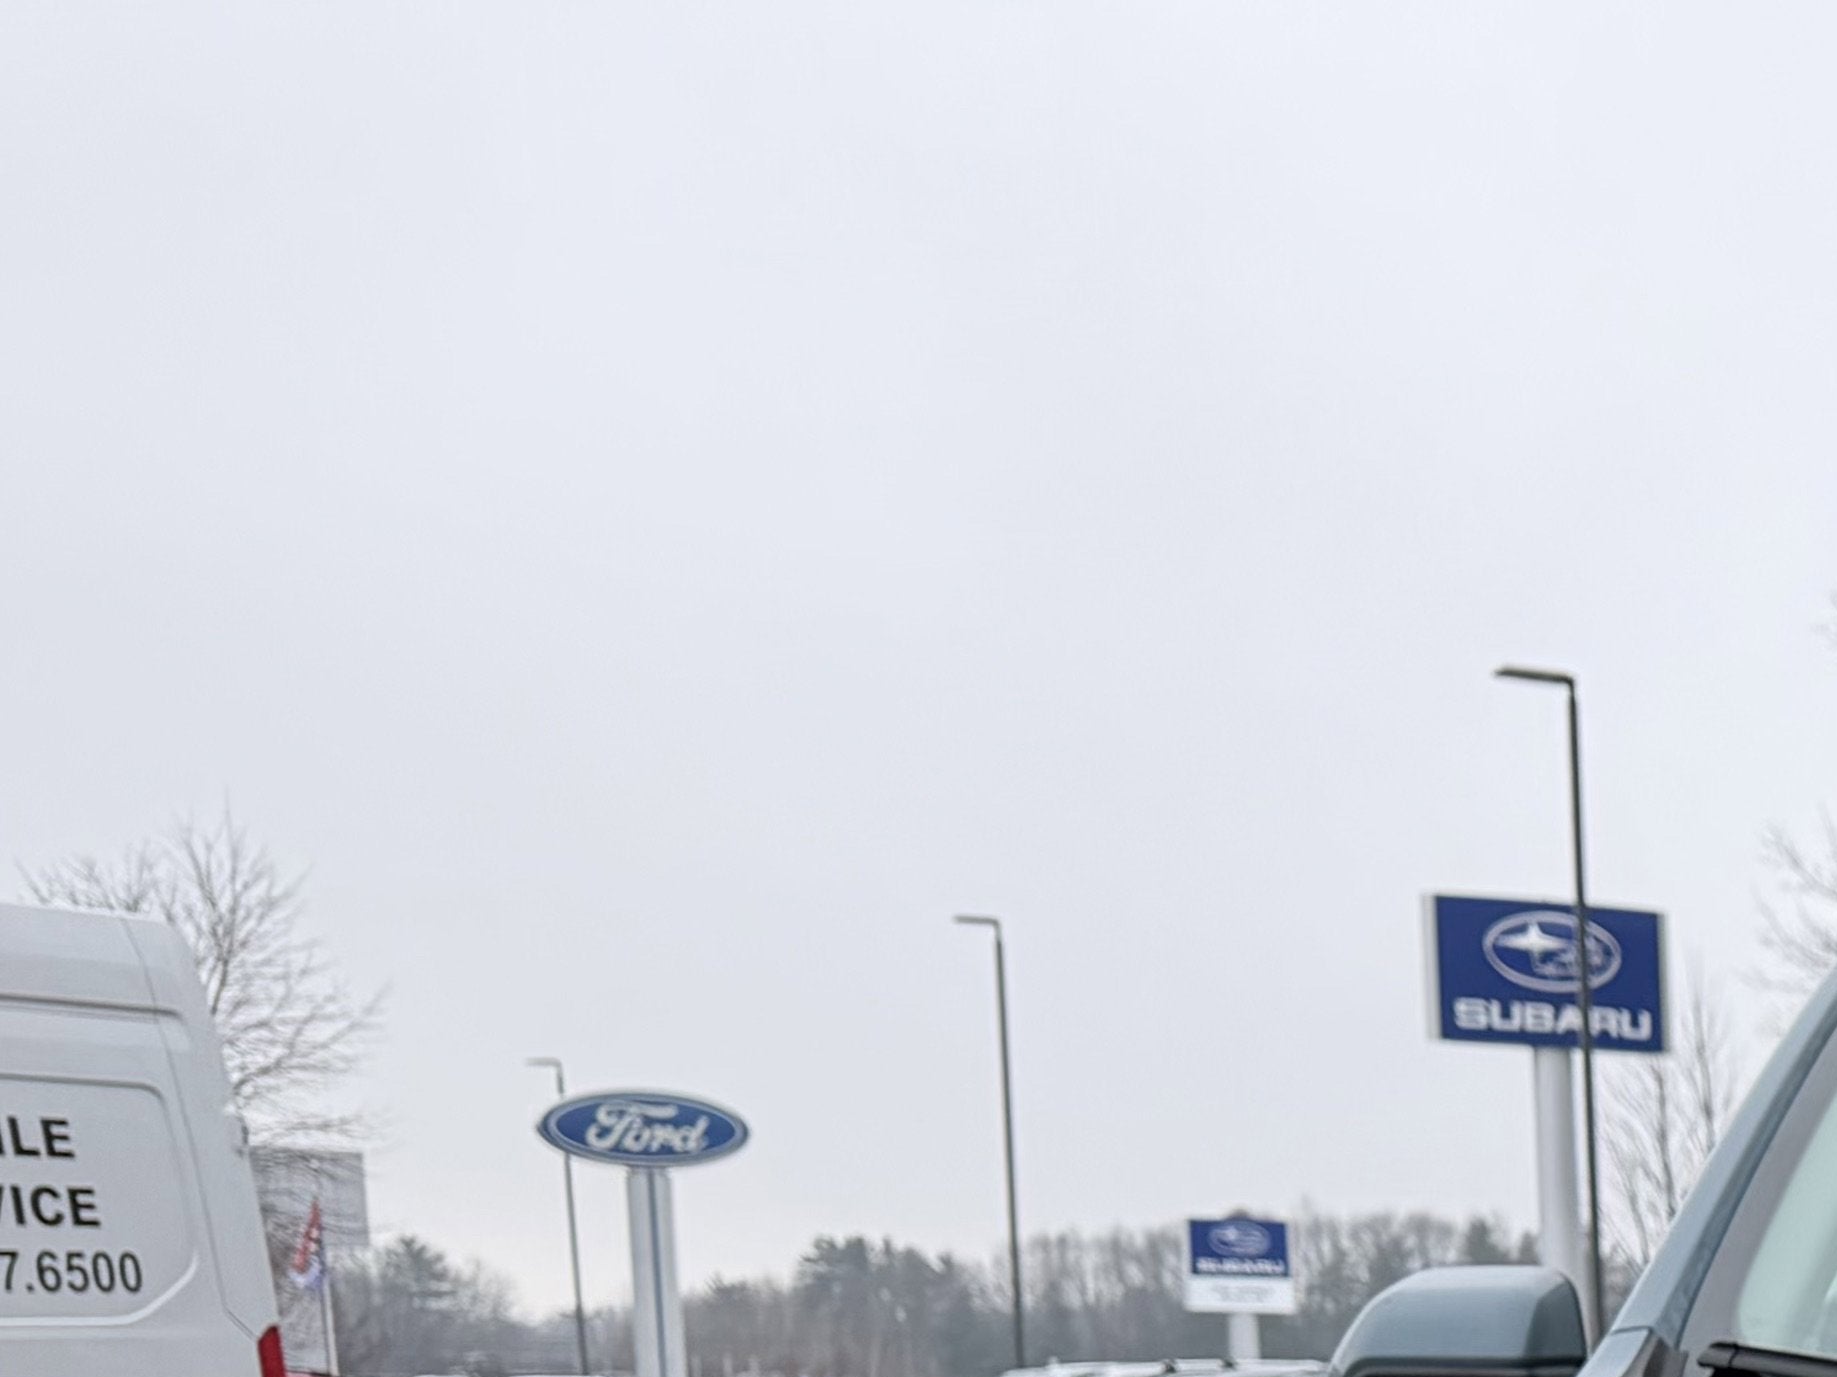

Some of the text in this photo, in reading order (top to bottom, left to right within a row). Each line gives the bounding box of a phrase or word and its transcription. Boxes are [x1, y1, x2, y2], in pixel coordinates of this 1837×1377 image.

[1454, 997, 1653, 1041] SUBARU
[585, 1099, 709, 1153] Ford
[0, 1185, 102, 1227] ICE
